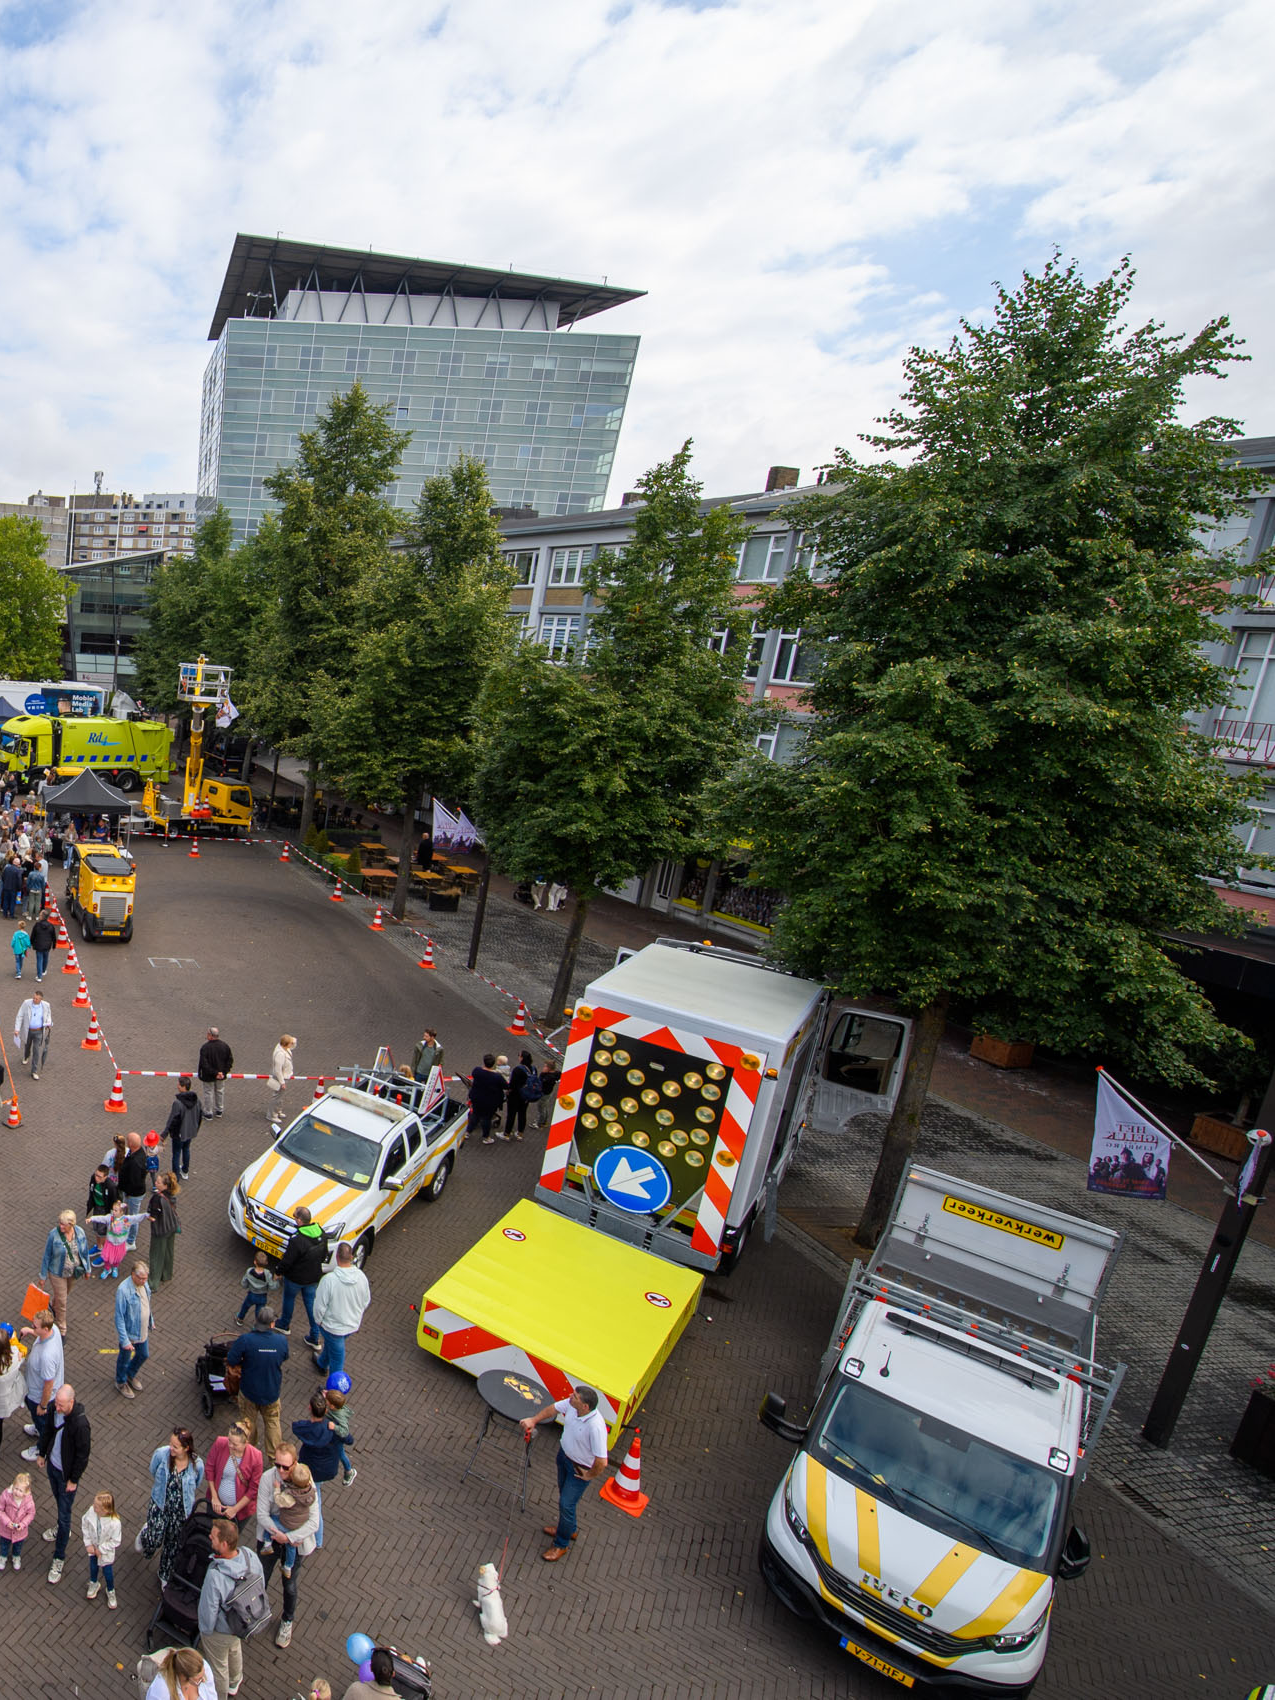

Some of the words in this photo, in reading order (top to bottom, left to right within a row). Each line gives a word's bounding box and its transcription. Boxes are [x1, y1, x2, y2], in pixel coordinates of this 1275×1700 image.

[72, 694, 96, 702] Mobiel
[949, 1202, 1056, 1243] werkverkeer
[862, 1572, 934, 1618] IVECO
[853, 1645, 907, 1683] V-71-HFJ
